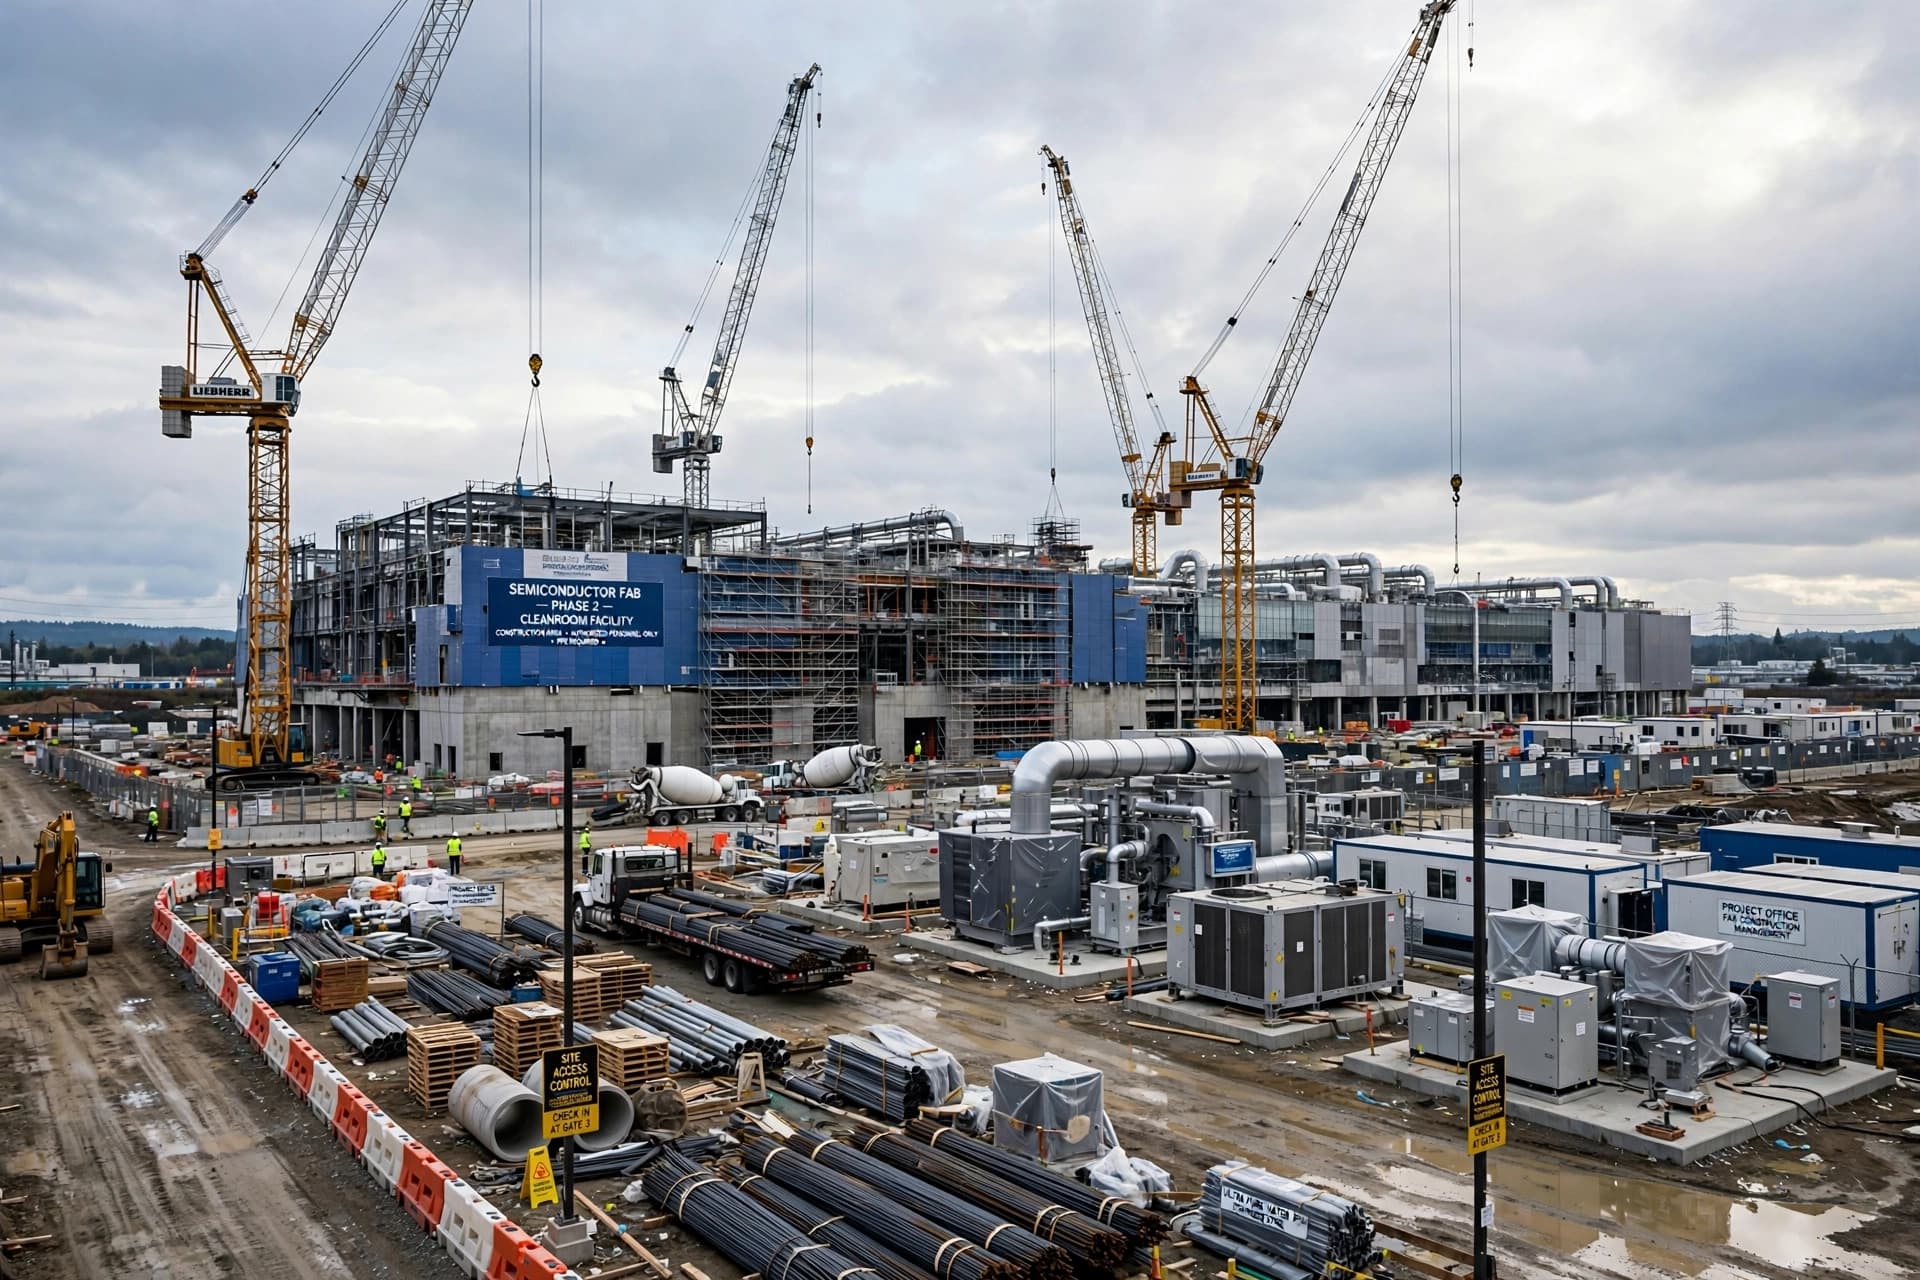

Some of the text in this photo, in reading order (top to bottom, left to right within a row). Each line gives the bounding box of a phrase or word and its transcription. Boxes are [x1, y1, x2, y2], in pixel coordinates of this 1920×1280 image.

[193, 386, 251, 397] LIEBHERR
[509, 583, 641, 599] SEMICONDUCTOR FAB
[551, 600, 599, 612] PHASE 2
[520, 613, 634, 627] CLEANROOM FACILITY
[1722, 903, 1798, 921] PROJECT OFFICE
[561, 1052, 581, 1063] SITE
[553, 1063, 588, 1077] ACCESS
[1480, 1063, 1495, 1076] SITE
[550, 1076, 592, 1091] CONTROL
[1475, 1075, 1499, 1090] ACCESS
[1473, 1089, 1501, 1105] CONTROL
[552, 1107, 591, 1122] CHECK IN
[550, 1119, 591, 1134] AT GATE 3
[1481, 1133, 1495, 1146] GATE
